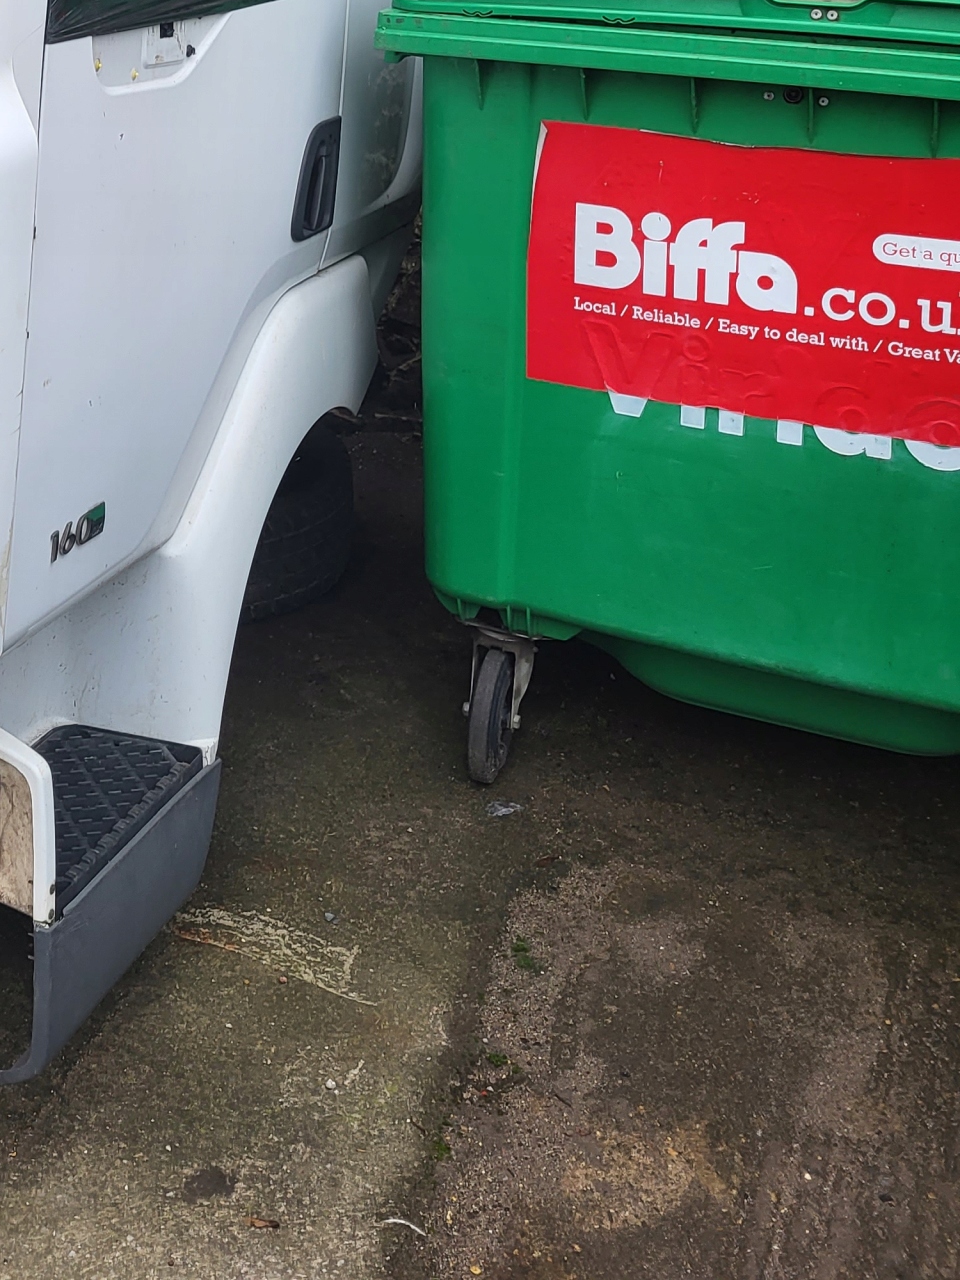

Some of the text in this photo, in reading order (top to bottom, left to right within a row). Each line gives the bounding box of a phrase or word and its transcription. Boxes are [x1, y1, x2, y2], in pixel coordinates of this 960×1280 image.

[574, 202, 960, 336] Biffa.co.u
[882, 242, 917, 259] Get
[923, 250, 934, 261] a
[573, 296, 617, 316] Local
[632, 306, 701, 329] Reliable
[717, 318, 760, 340] Easy
[763, 326, 781, 340] to
[785, 328, 826, 346] deal
[829, 335, 869, 352] with
[887, 341, 941, 362] Great
[50, 512, 92, 564] 160
